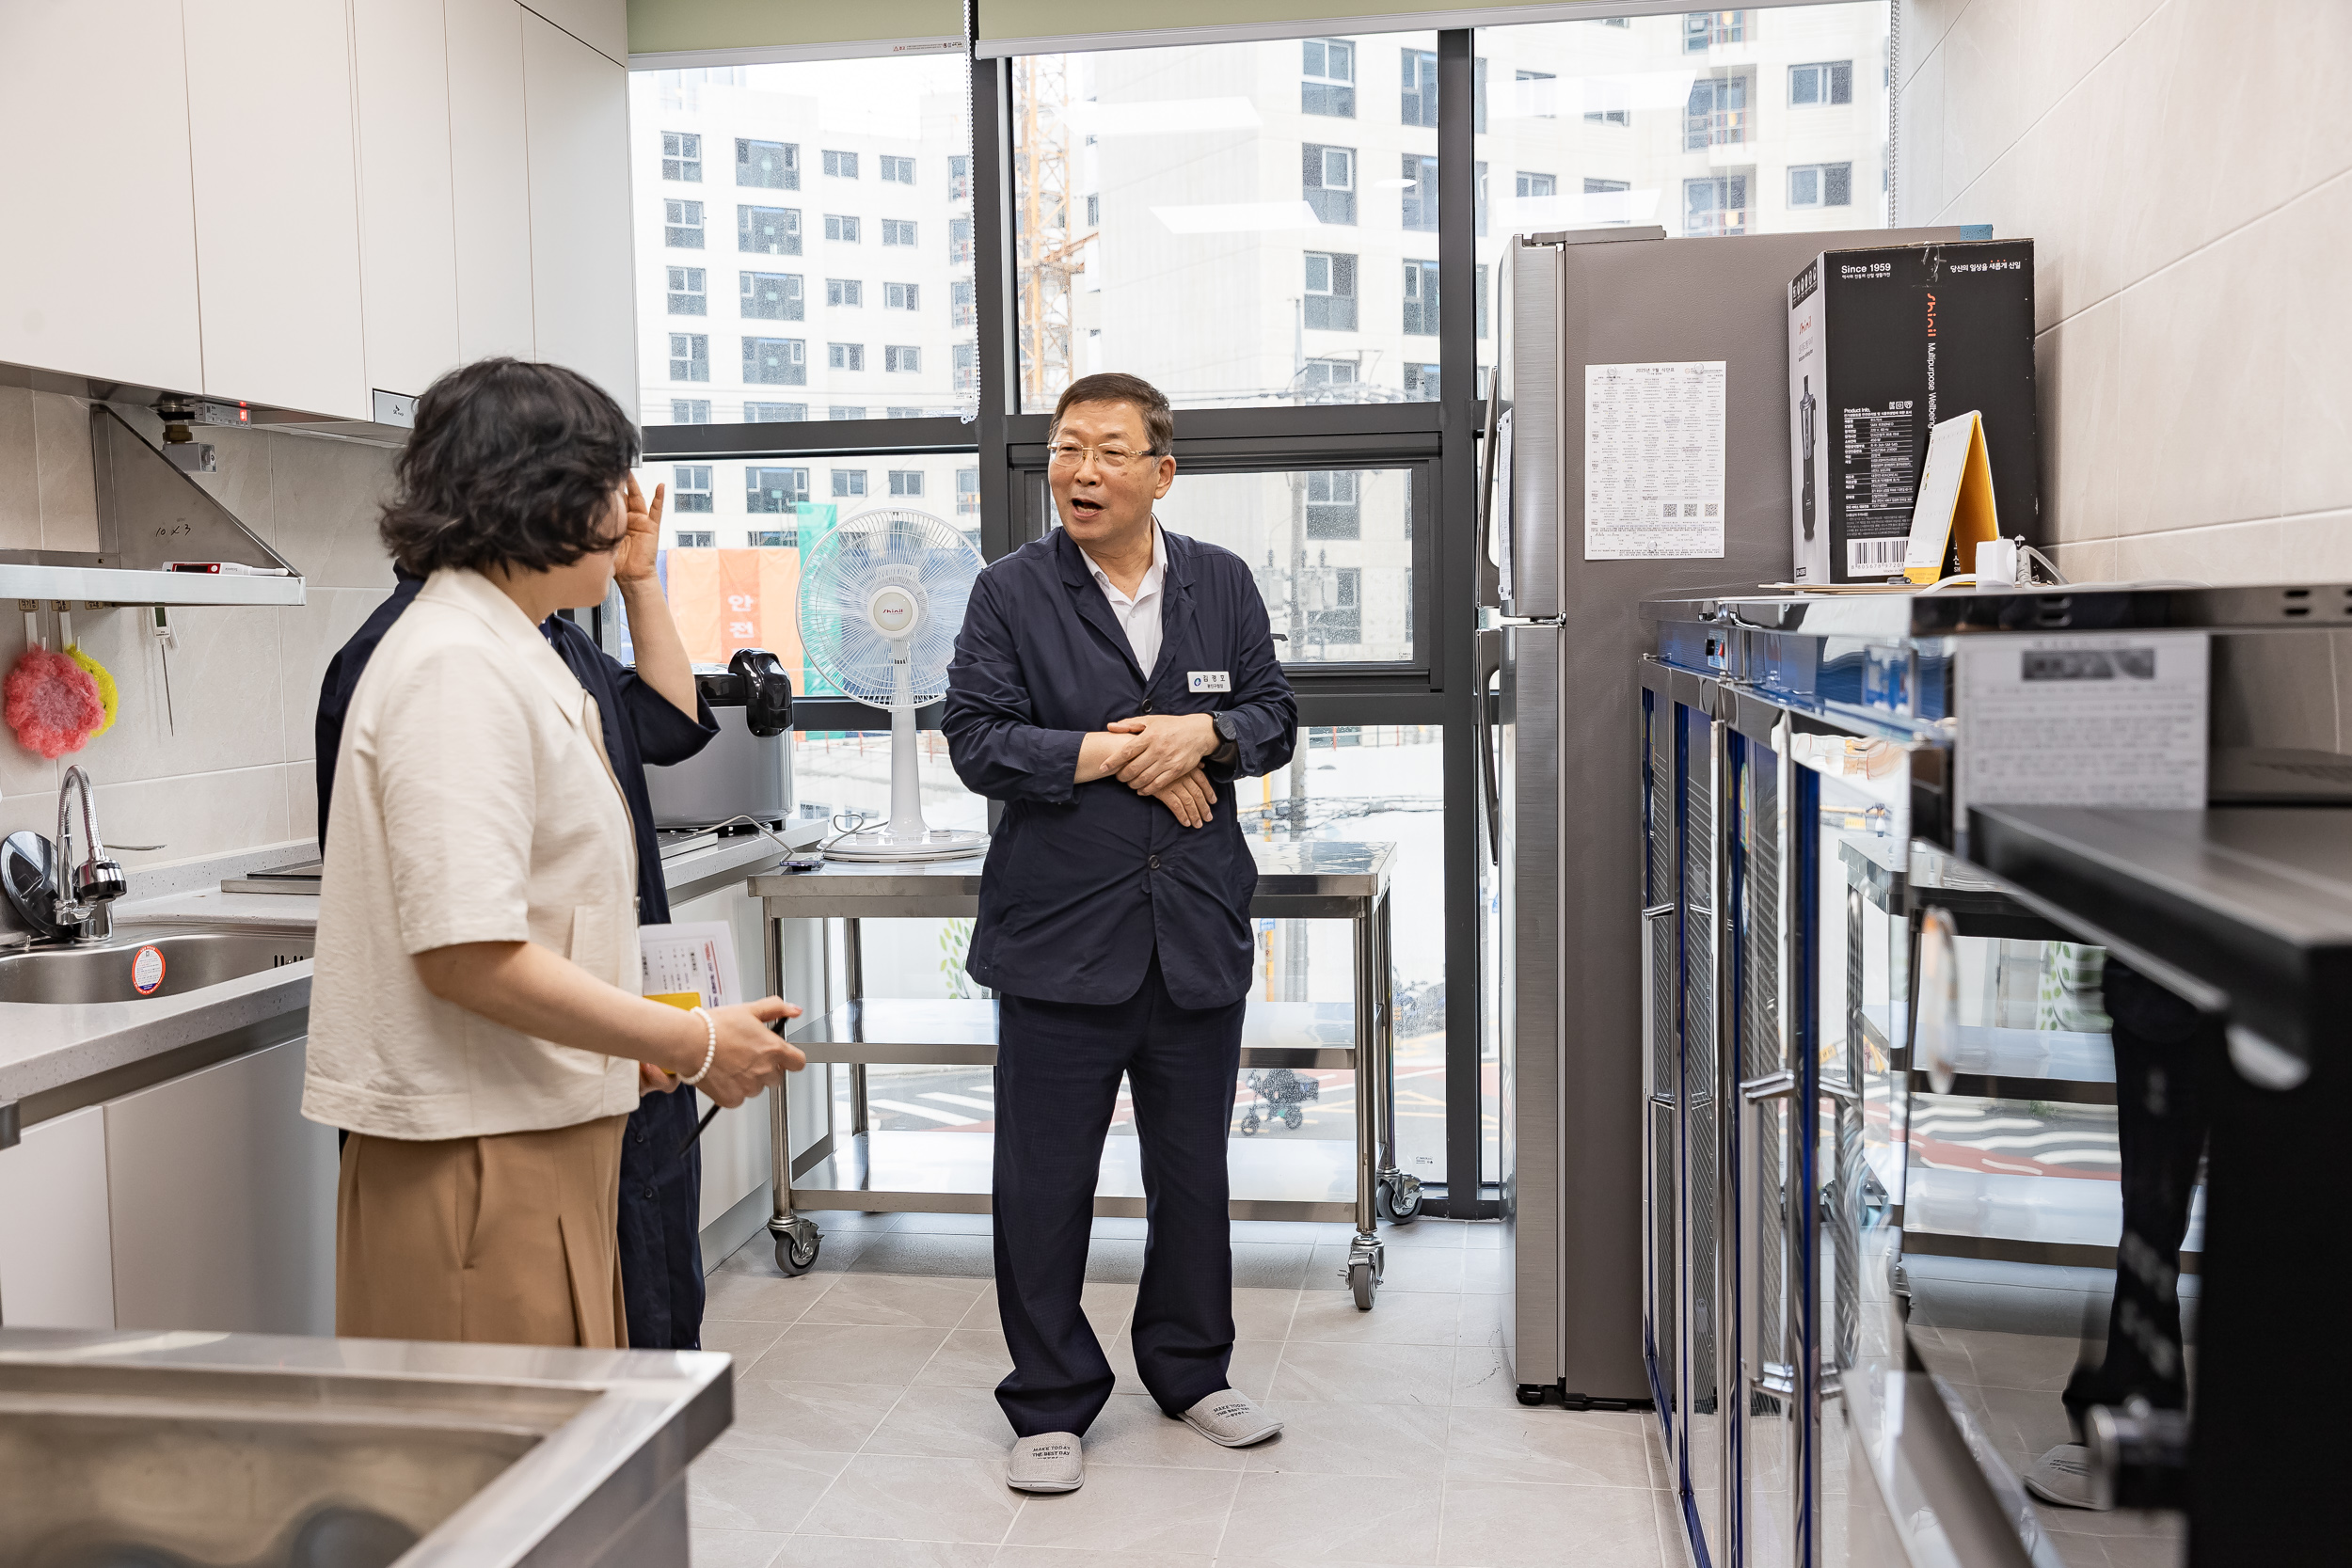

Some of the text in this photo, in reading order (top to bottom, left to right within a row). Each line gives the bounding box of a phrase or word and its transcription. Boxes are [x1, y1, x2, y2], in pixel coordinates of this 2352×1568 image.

[1841, 262, 1891, 274] Since 1959
[1950, 261, 2021, 273] 당신의 일상을 새롭게 신일
[1927, 342, 1937, 429] Multipurpose Wellbeing
[727, 594, 755, 639] 안전
